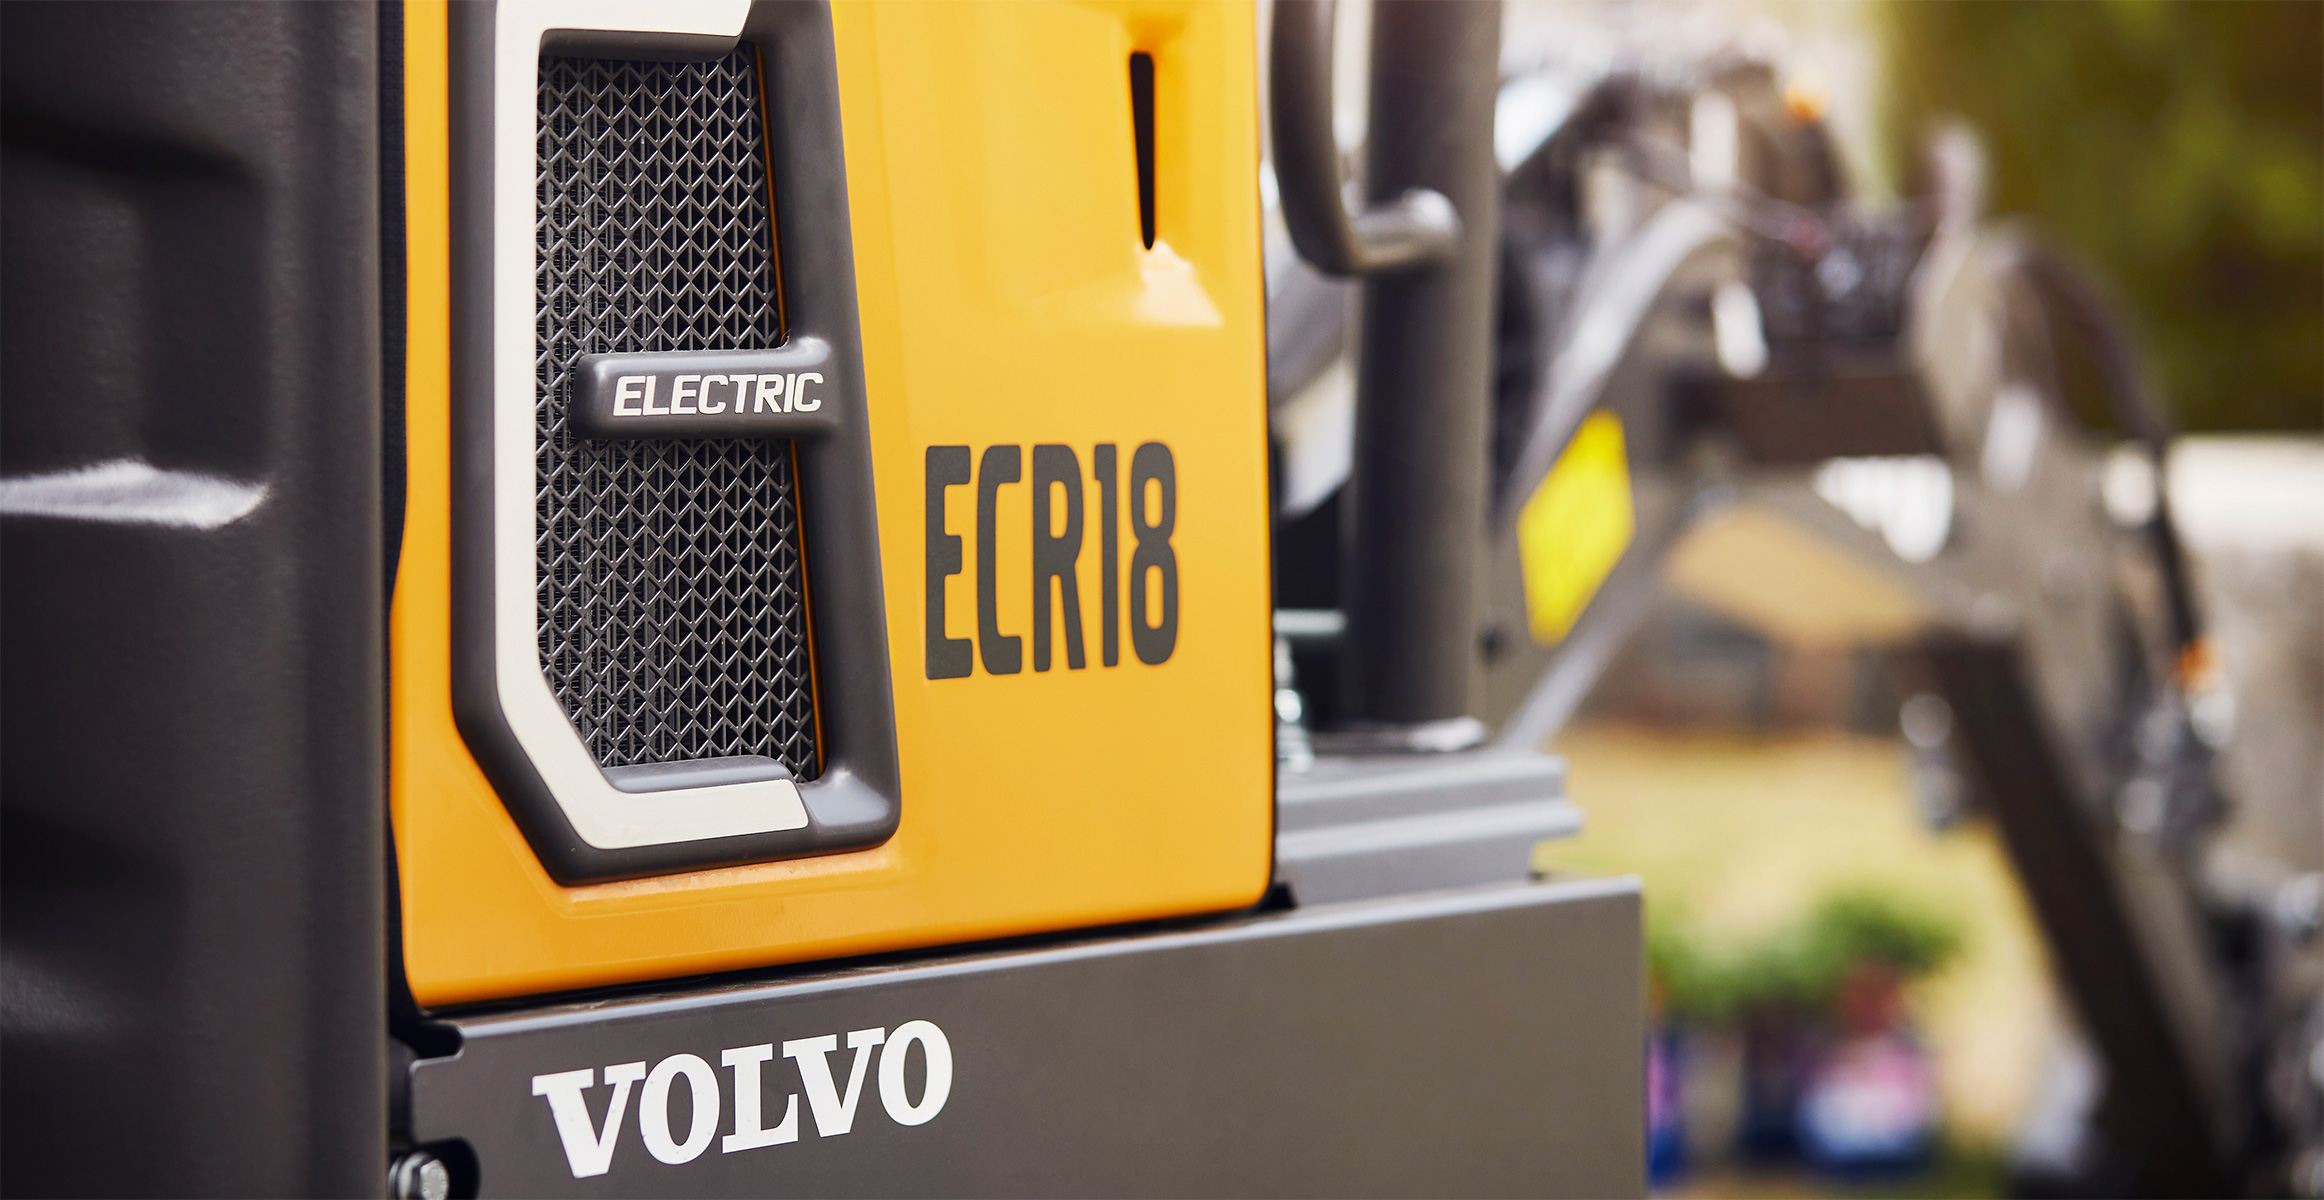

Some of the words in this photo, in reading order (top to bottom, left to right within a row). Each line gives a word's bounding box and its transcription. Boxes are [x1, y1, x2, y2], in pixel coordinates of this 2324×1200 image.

[612, 372, 824, 417] ELECTRIC
[925, 442, 1180, 682] ECR18
[532, 1019, 953, 1179] VOLVO
